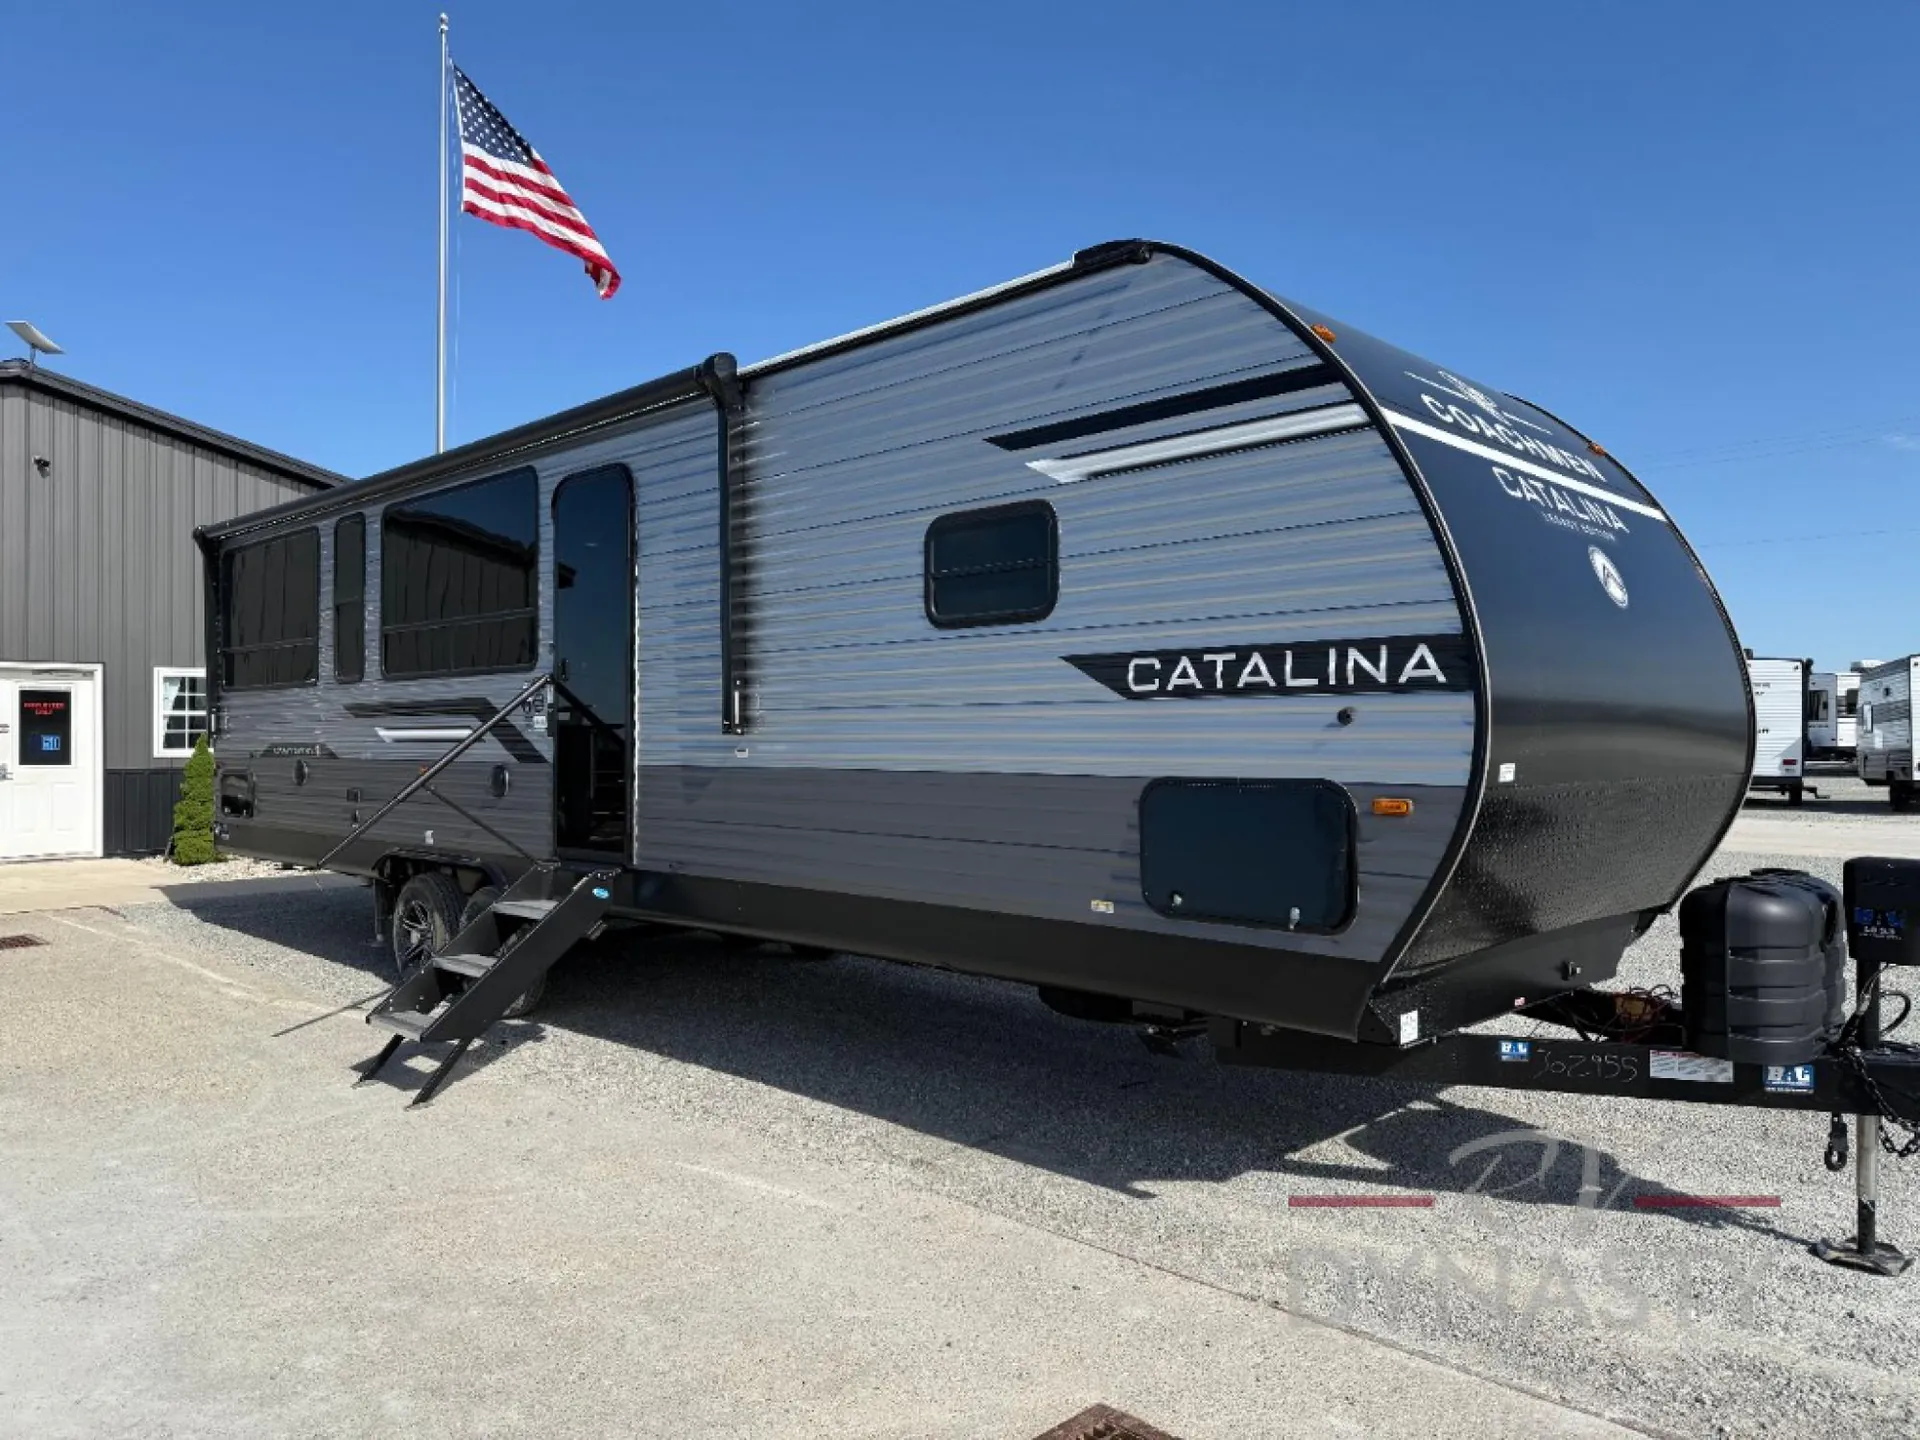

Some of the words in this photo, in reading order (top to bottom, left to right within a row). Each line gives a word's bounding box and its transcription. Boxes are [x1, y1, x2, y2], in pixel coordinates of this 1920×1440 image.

[1421, 393, 1607, 482] COACHMEN
[1492, 467, 1630, 533] CATALINA
[1127, 642, 1448, 693] CATALINA
